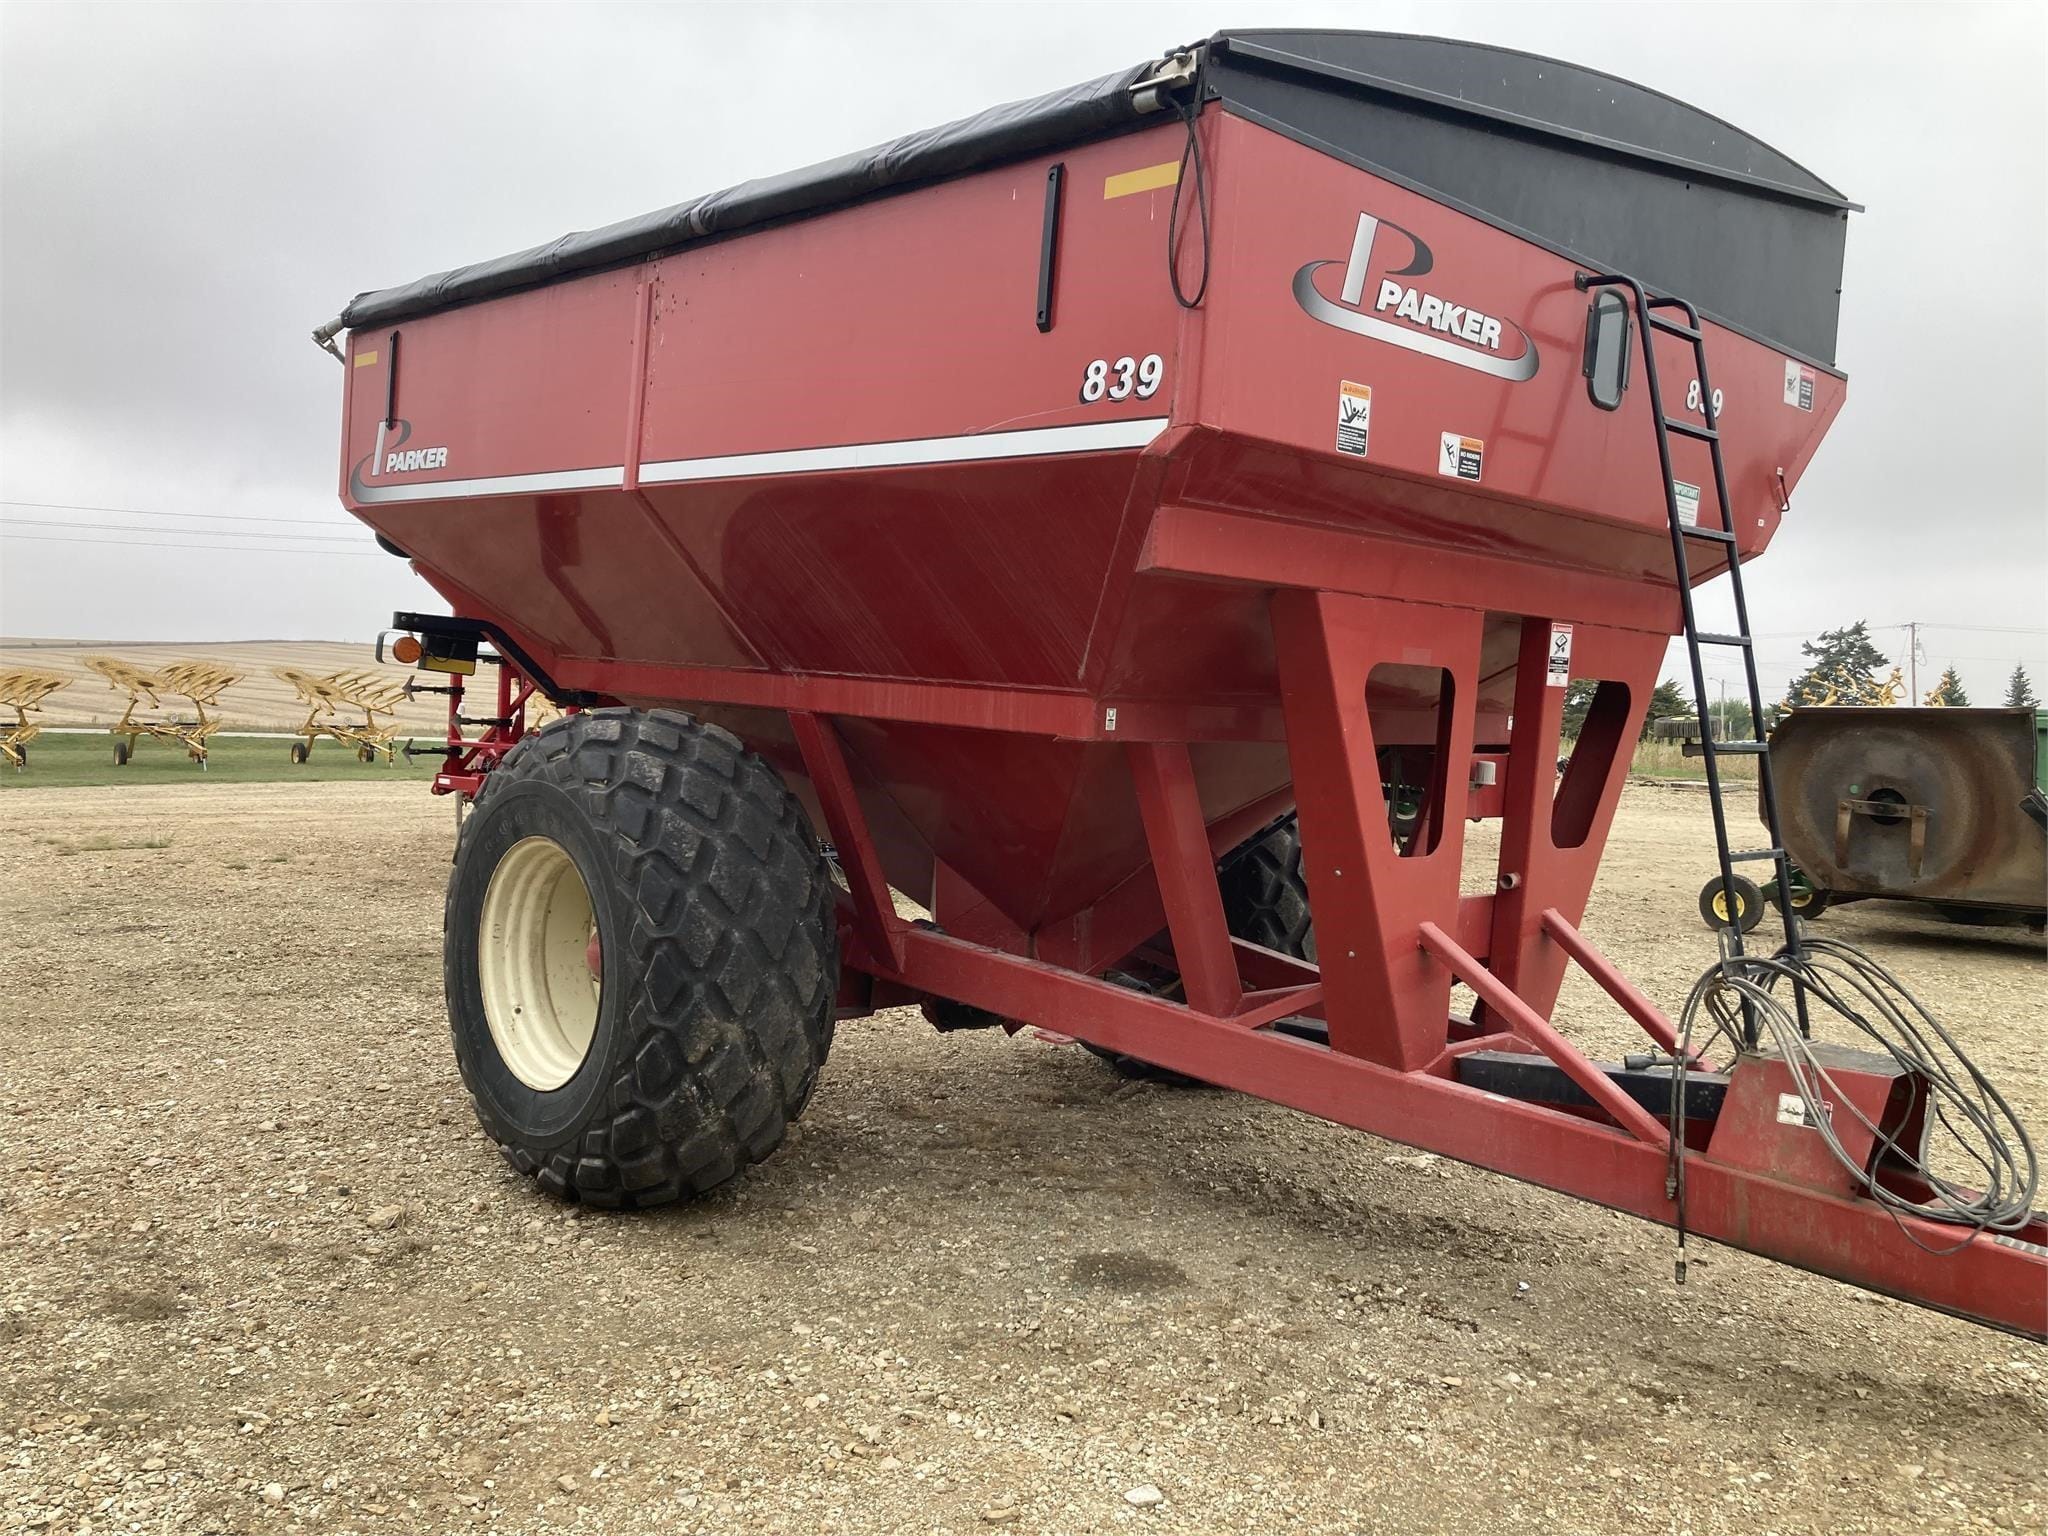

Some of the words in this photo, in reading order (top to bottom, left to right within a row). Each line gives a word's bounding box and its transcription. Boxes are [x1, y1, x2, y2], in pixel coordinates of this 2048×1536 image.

[1376, 278, 1502, 350] PARKER
[1080, 352, 1163, 403] 839
[1686, 379, 1723, 418] 89
[385, 446, 448, 473] PARKER
